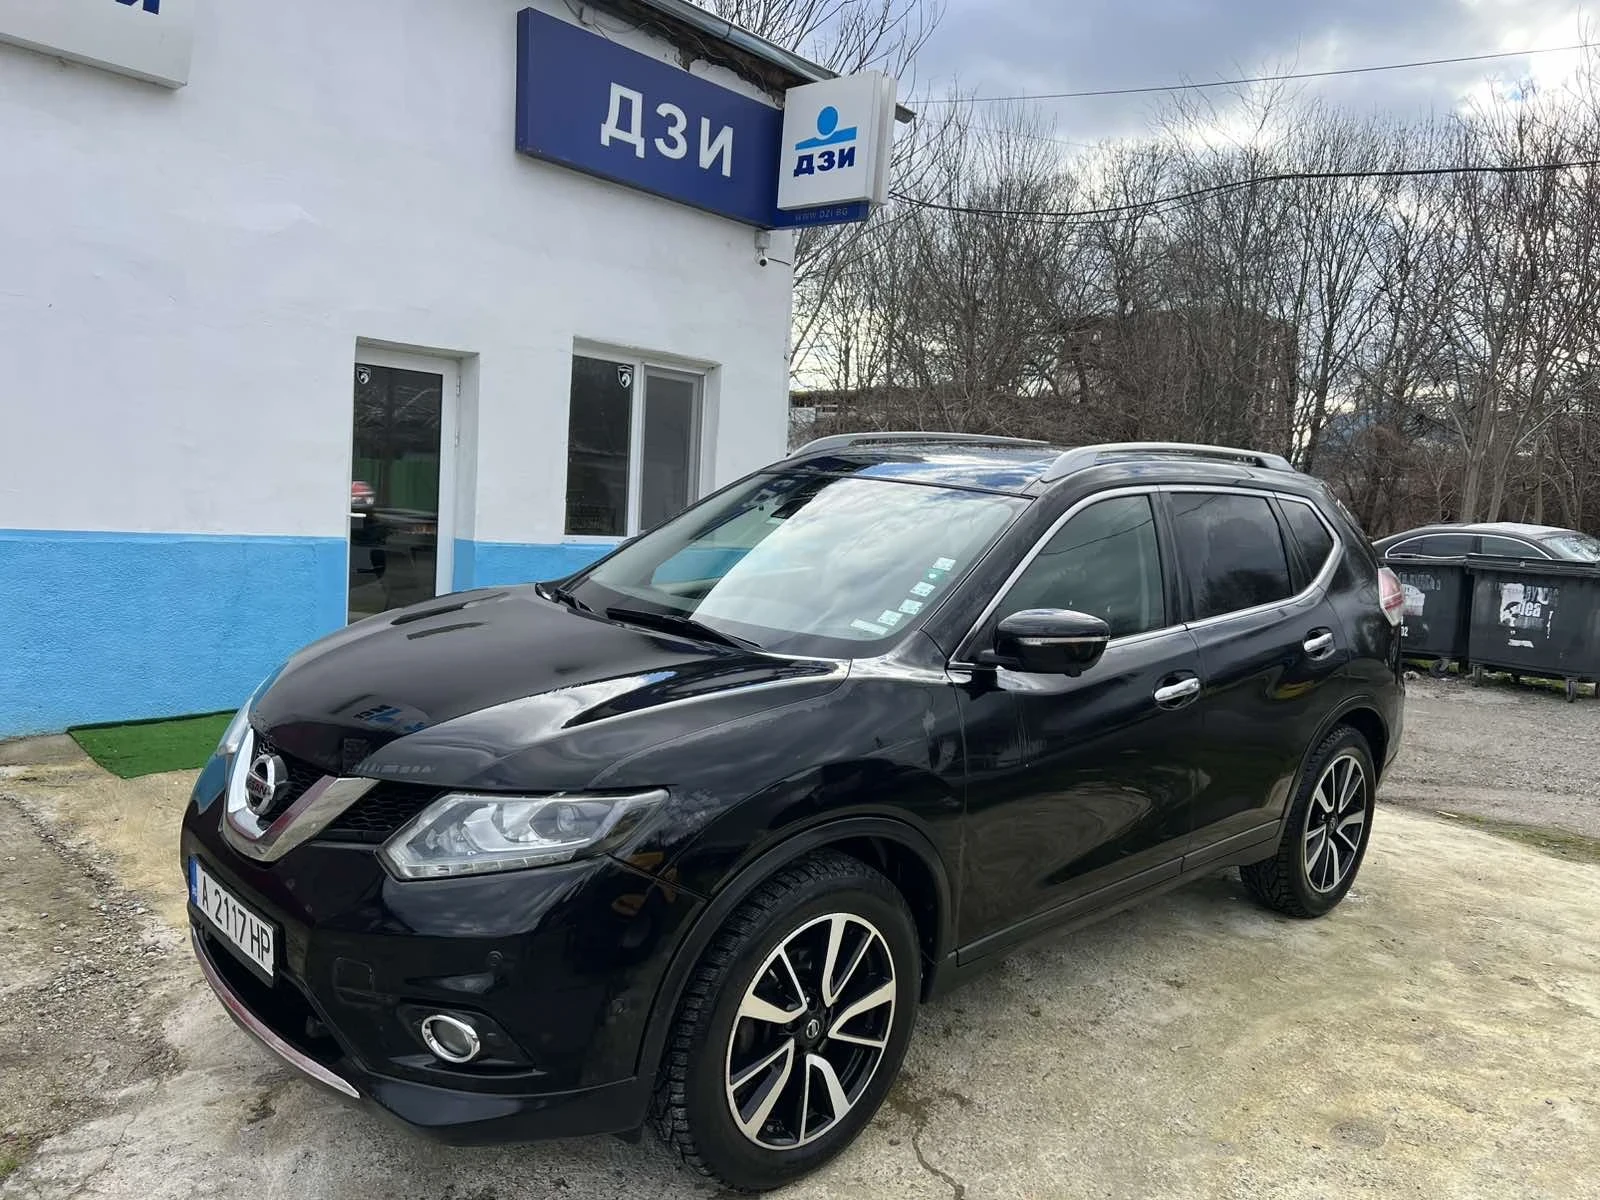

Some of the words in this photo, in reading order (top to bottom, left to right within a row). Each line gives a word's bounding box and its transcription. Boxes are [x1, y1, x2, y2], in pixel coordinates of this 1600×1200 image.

[600, 82, 734, 178] ДЗИ
[794, 146, 856, 178] ДЗИ
[214, 888, 247, 943] 2117
